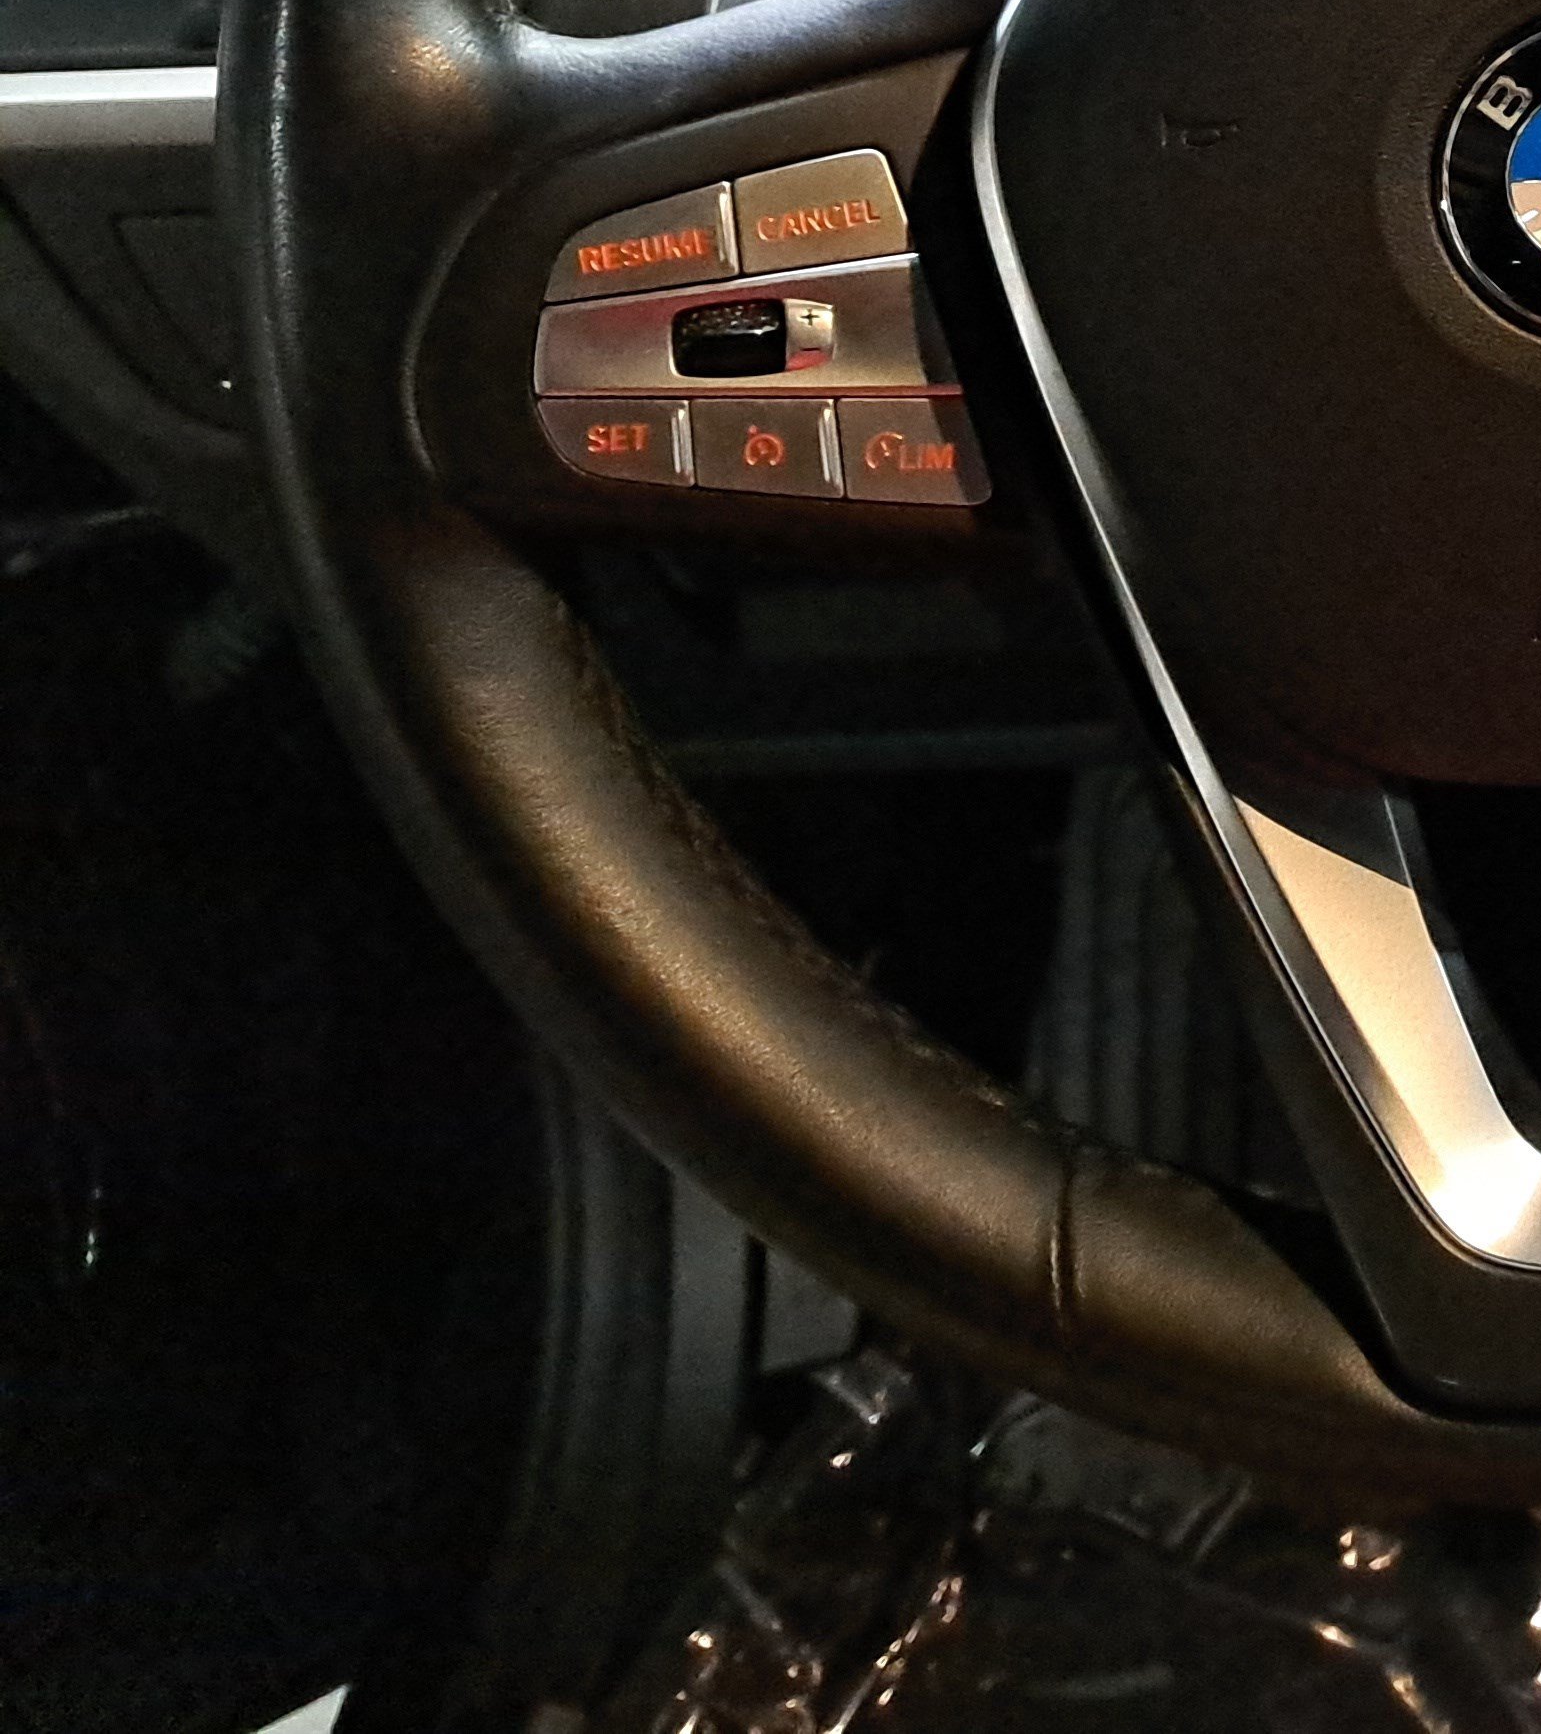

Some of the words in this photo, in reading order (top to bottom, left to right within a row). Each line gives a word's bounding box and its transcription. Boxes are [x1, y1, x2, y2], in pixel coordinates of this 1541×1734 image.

[757, 200, 881, 242] CANCEL
[578, 228, 709, 275] RESUME
[586, 422, 650, 455] SET
[899, 444, 955, 470] LIM
